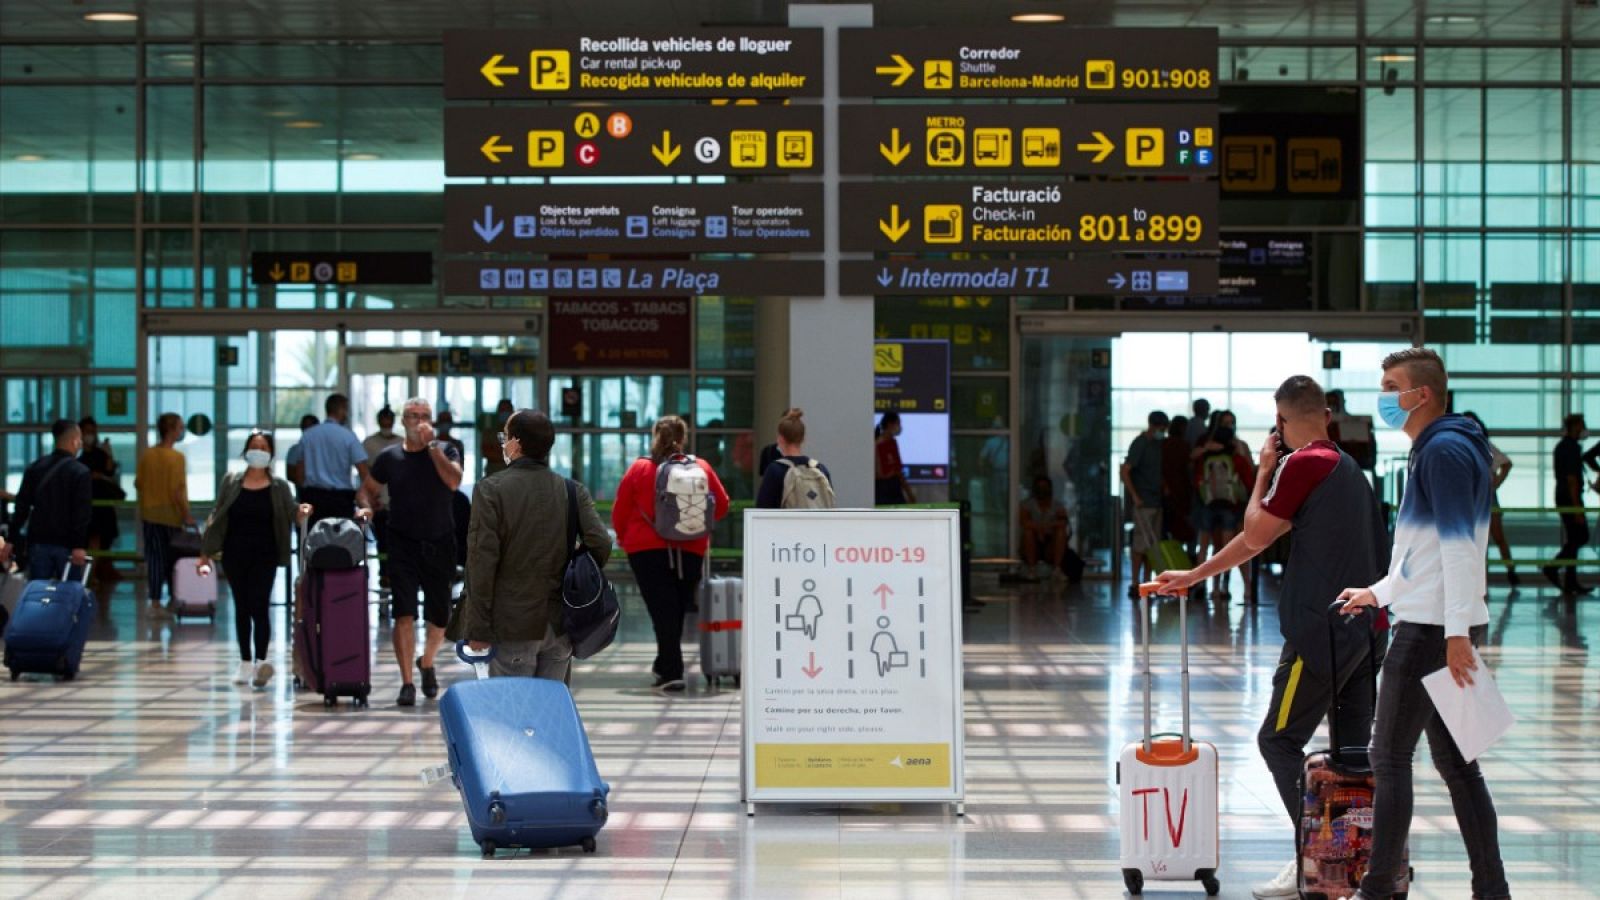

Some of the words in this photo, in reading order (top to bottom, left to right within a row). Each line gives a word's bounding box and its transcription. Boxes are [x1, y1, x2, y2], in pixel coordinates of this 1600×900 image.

[581, 37, 648, 52] Recollida
[652, 37, 712, 52] vehicles
[717, 37, 735, 51] de
[740, 37, 792, 54] lloguer
[960, 47, 1020, 59] Corredor
[580, 56, 600, 69] Car
[605, 57, 637, 69] rental
[641, 57, 681, 71] pick-up
[960, 61, 996, 73] Shuttle
[581, 73, 650, 90] Recogida
[654, 73, 723, 87] vehículos
[728, 73, 746, 87] de
[750, 73, 805, 90] alquiler
[960, 75, 1079, 88] Barcelona-Madrid
[1122, 70, 1160, 88] 901
[1170, 70, 1211, 88] 908
[581, 117, 594, 134] A
[613, 117, 627, 134] B
[927, 117, 964, 128] METRO
[733, 134, 764, 143] HOTEL
[1179, 130, 1190, 145] D
[538, 138, 556, 160] P
[580, 145, 594, 164] C
[700, 141, 715, 159] G
[1136, 135, 1155, 160] P
[1179, 150, 1188, 164] F
[1199, 150, 1208, 164] E
[973, 186, 1060, 202] Facturació
[540, 206, 580, 217] Objectes
[584, 206, 620, 218] perduts
[652, 206, 696, 218] Consigna
[732, 206, 753, 216] Tour
[756, 206, 803, 218] operadors
[973, 206, 1035, 221] Check-in
[1133, 207, 1147, 222] to
[540, 217, 557, 226] Lost
[559, 217, 566, 226] &
[569, 217, 592, 226] found
[652, 217, 666, 226] Left
[668, 217, 702, 228] luggage
[732, 217, 749, 226] Tour
[750, 218, 790, 228] operators
[971, 223, 1072, 241] Facturación
[1079, 215, 1130, 241] 801
[1136, 229, 1145, 241] a
[1148, 215, 1202, 241] 899
[540, 227, 576, 239] Objetos
[579, 227, 620, 239] perdidos
[652, 227, 696, 239] Consigna
[732, 227, 753, 238] Tour
[756, 227, 811, 239] Operadores
[628, 268, 653, 288] La
[661, 268, 719, 294] Plaça
[900, 268, 1017, 288] Intermodal
[1025, 267, 1049, 287] T1
[554, 302, 618, 314] TABACOS
[632, 302, 687, 314] TABACS
[582, 319, 659, 332] TOBACCOS
[771, 543, 816, 563] info
[834, 546, 925, 563] COVID-19
[765, 706, 795, 714] Camine
[826, 706, 861, 715] derecha,
[863, 708, 877, 716] por
[906, 757, 931, 766] aena
[1131, 787, 1188, 849] TV
